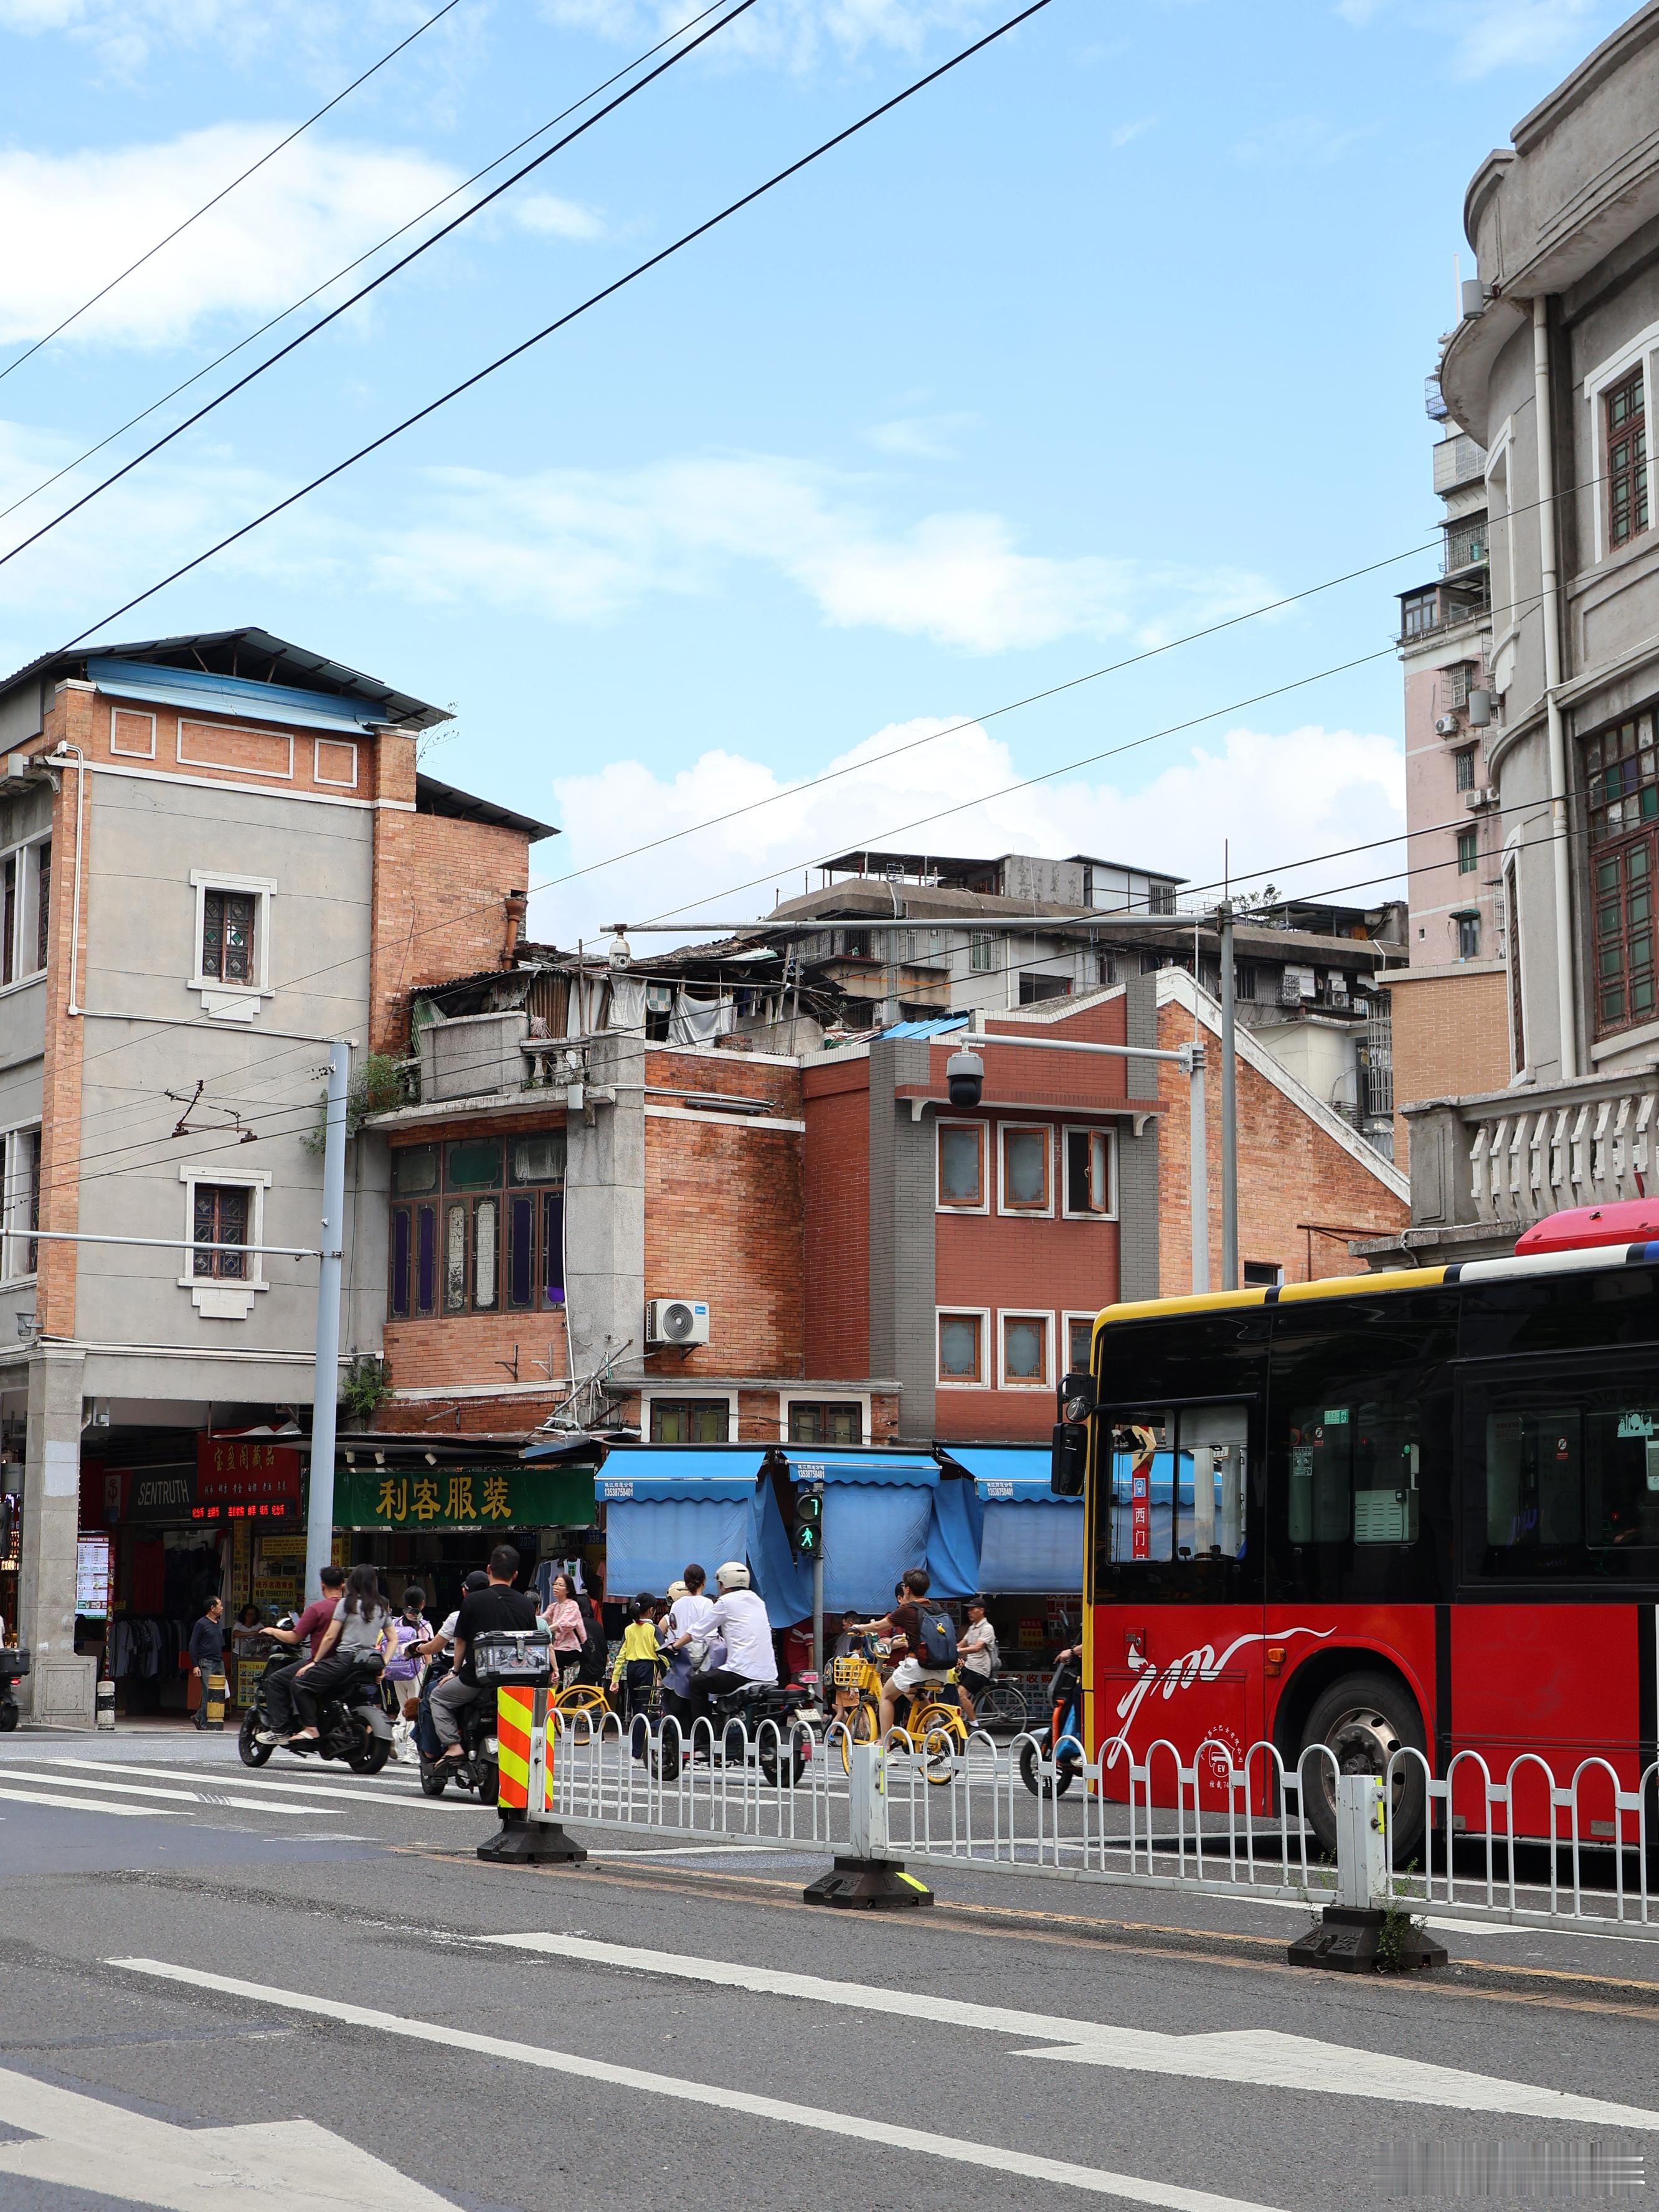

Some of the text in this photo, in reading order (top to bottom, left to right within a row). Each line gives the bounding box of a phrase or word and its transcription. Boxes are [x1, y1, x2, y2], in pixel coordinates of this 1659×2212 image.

[138, 1480, 189, 1506] SENTRUTH
[376, 1477, 512, 1521] 利客服装
[604, 1488, 633, 1496] 13538758401
[811, 1499, 818, 1516] 7
[1217, 1764, 1226, 1772] EV
